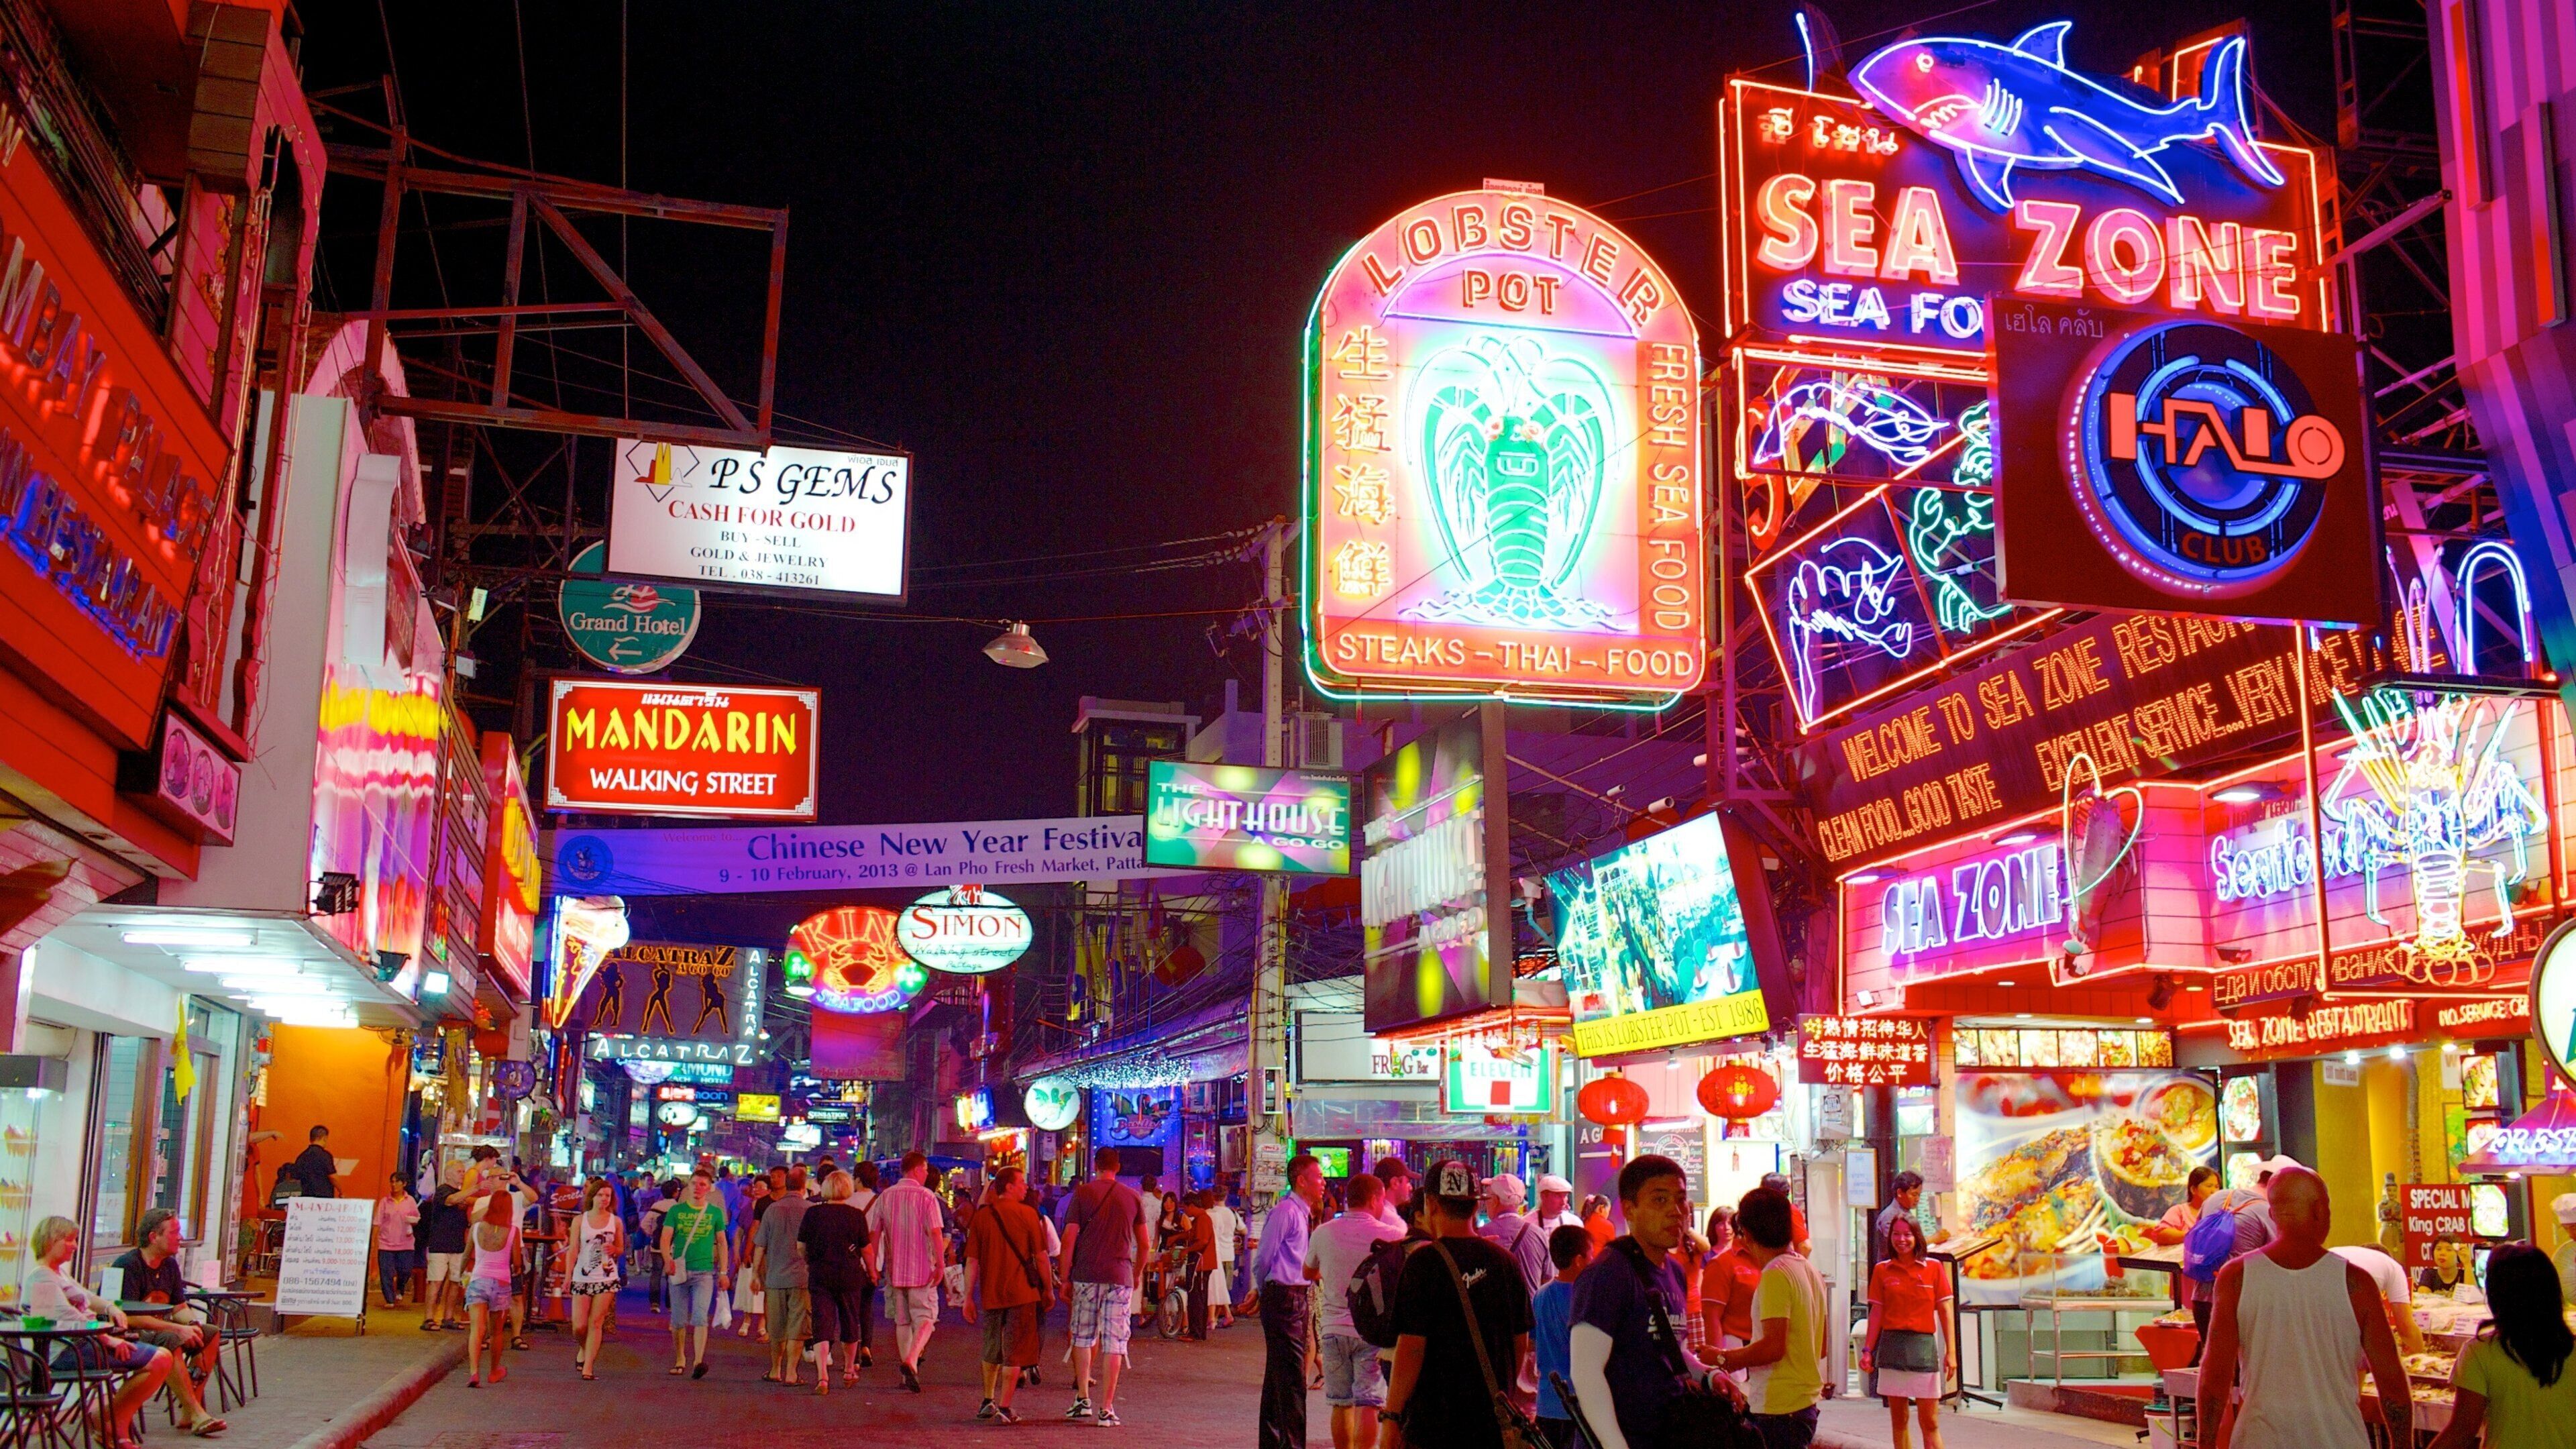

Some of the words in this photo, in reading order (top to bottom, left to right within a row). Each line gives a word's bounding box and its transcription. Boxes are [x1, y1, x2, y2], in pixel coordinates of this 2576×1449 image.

[1757, 173, 1960, 286] SEA
[2013, 199, 2302, 320] ZONE
[1363, 202, 1664, 329] LOBSTER
[1462, 268, 1562, 315] POT
[1782, 279, 1890, 333] SEA
[2059, 309, 2103, 338] คลับ
[1646, 341, 1689, 449] FRESH
[2108, 392, 2345, 480] HALO
[708, 457, 766, 494] PS
[776, 463, 898, 506] GEMS
[1648, 465, 1690, 525] SEA
[668, 498, 730, 523] CASH
[737, 506, 784, 528] FOR
[790, 510, 857, 535] GOLD
[719, 531, 749, 545] BUY
[763, 535, 802, 549] SELL
[2181, 531, 2269, 566] CLUB
[690, 546, 735, 561] GOLD
[739, 551, 750, 563] &
[754, 552, 830, 569] JEWELRY
[698, 564, 729, 579] TEL
[740, 568, 763, 582] 038
[775, 571, 820, 586] 413261
[1649, 539, 1691, 631] FOOD
[569, 612, 629, 634] Grand
[633, 615, 688, 637] Hotel
[1337, 633, 1465, 667] STEAKS
[1497, 641, 1571, 672] THAI
[1607, 648, 1694, 676] FOOD
[1841, 705, 1942, 782] WELCOME
[1937, 692, 1975, 745] TO
[1978, 670, 2035, 729] SEA
[2033, 637, 2110, 710] ZONE
[566, 706, 797, 756] MANDARIN
[590, 767, 699, 796] WALKING
[706, 771, 777, 796] STREET
[1157, 783, 1207, 794] THE
[1157, 796, 1345, 837] LIGHTHOUSE
[1817, 804, 1862, 863] CLEAN
[1945, 762, 2002, 820] TASTE
[662, 832, 716, 843] Welcome
[747, 833, 865, 861] Chinese
[880, 832, 947, 857] New
[962, 827, 1029, 855] Year
[1250, 837, 1267, 845] A
[1271, 837, 1305, 849] GO
[1311, 839, 1345, 849] GO
[720, 869, 729, 883] 9
[752, 867, 770, 881] 10
[777, 865, 853, 884] February,
[857, 862, 898, 879] 2013
[904, 863, 919, 878] @
[925, 861, 952, 876] Lan
[959, 861, 988, 875] Pho
[995, 859, 1034, 873] Fresh
[1042, 857, 1099, 873] Market,
[1882, 876, 1947, 956] SEA
[1953, 843, 2061, 943] ZONE
[911, 906, 1022, 939] SIMON
[914, 946, 966, 959] Walking
[973, 947, 1016, 957] street
[676, 963, 687, 975] A
[688, 965, 707, 975] GO
[712, 966, 730, 977] GO
[816, 989, 900, 1013] SEAFOOD
[2214, 975, 2247, 1004] Еда
[1578, 1026, 1604, 1051] THIS
[1604, 1024, 1615, 1046] IS
[1615, 1016, 1665, 1045] LOBSTER
[1666, 1011, 1691, 1036] POT
[1729, 998, 1764, 1027] 1986
[1823, 1017, 1927, 1040] 热情招待华人
[593, 1038, 753, 1065] ALCATRAZ
[1825, 1062, 1907, 1084] 价格公平
[550, 1190, 584, 1205] Secrets
[2410, 1189, 2458, 1210] SPECIAL
[2408, 1216, 2433, 1236] King
[2435, 1217, 2465, 1232] CRAB
